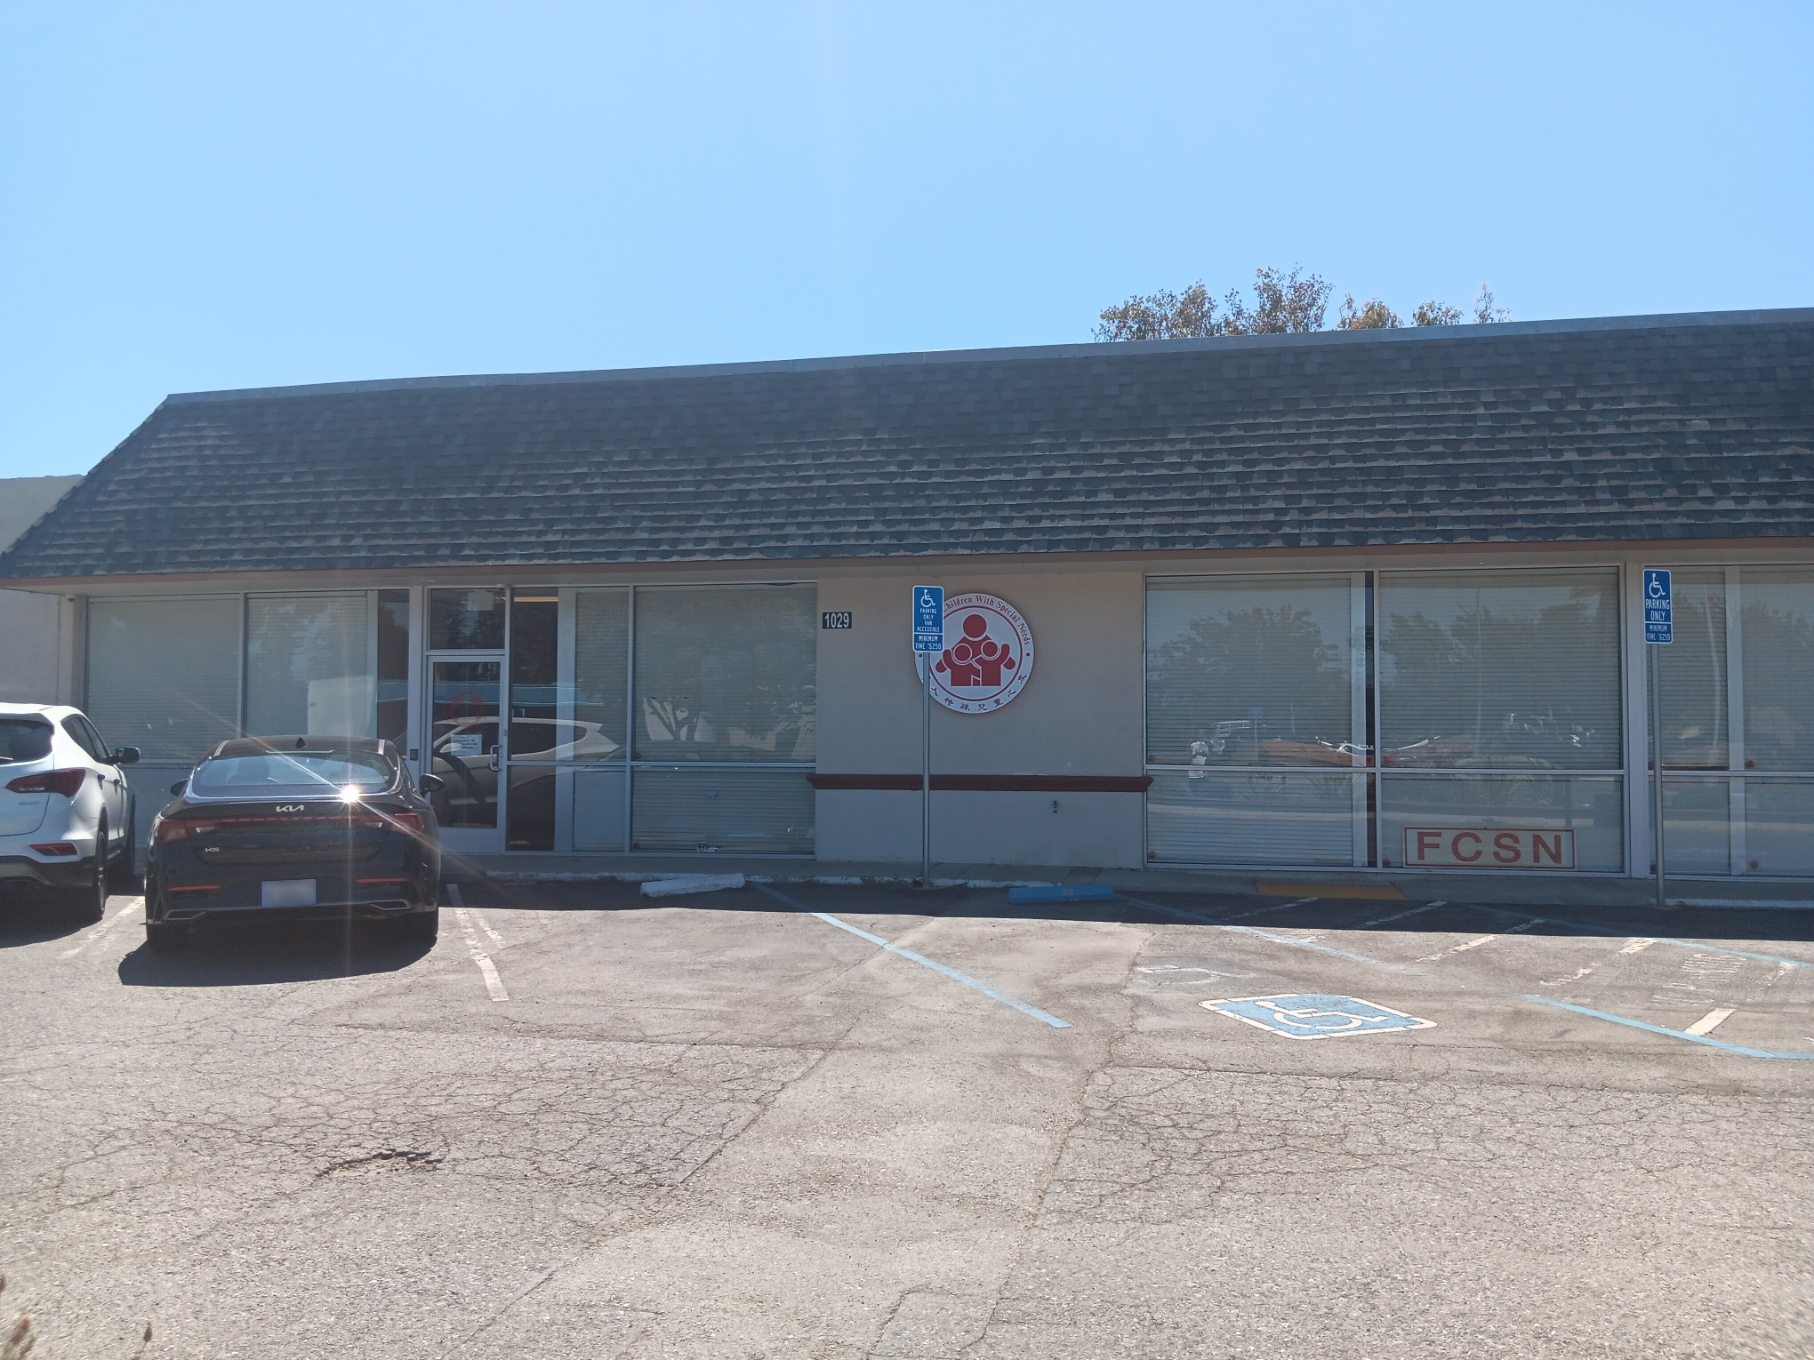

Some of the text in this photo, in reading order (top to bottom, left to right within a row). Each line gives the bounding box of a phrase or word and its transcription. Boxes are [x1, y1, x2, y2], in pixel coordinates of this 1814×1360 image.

[1645, 599, 1670, 610] PARKING
[824, 612, 850, 629] 1029
[976, 595, 994, 606] With
[996, 601, 1020, 622] Special
[1018, 622, 1031, 645] Needs
[1650, 610, 1666, 621] ONLY
[1649, 624, 1668, 632] MINIMUM
[915, 642, 942, 650] FINE $250
[919, 674, 1027, 711] 人特殊兒童之友
[1416, 831, 1562, 864] FCSN
